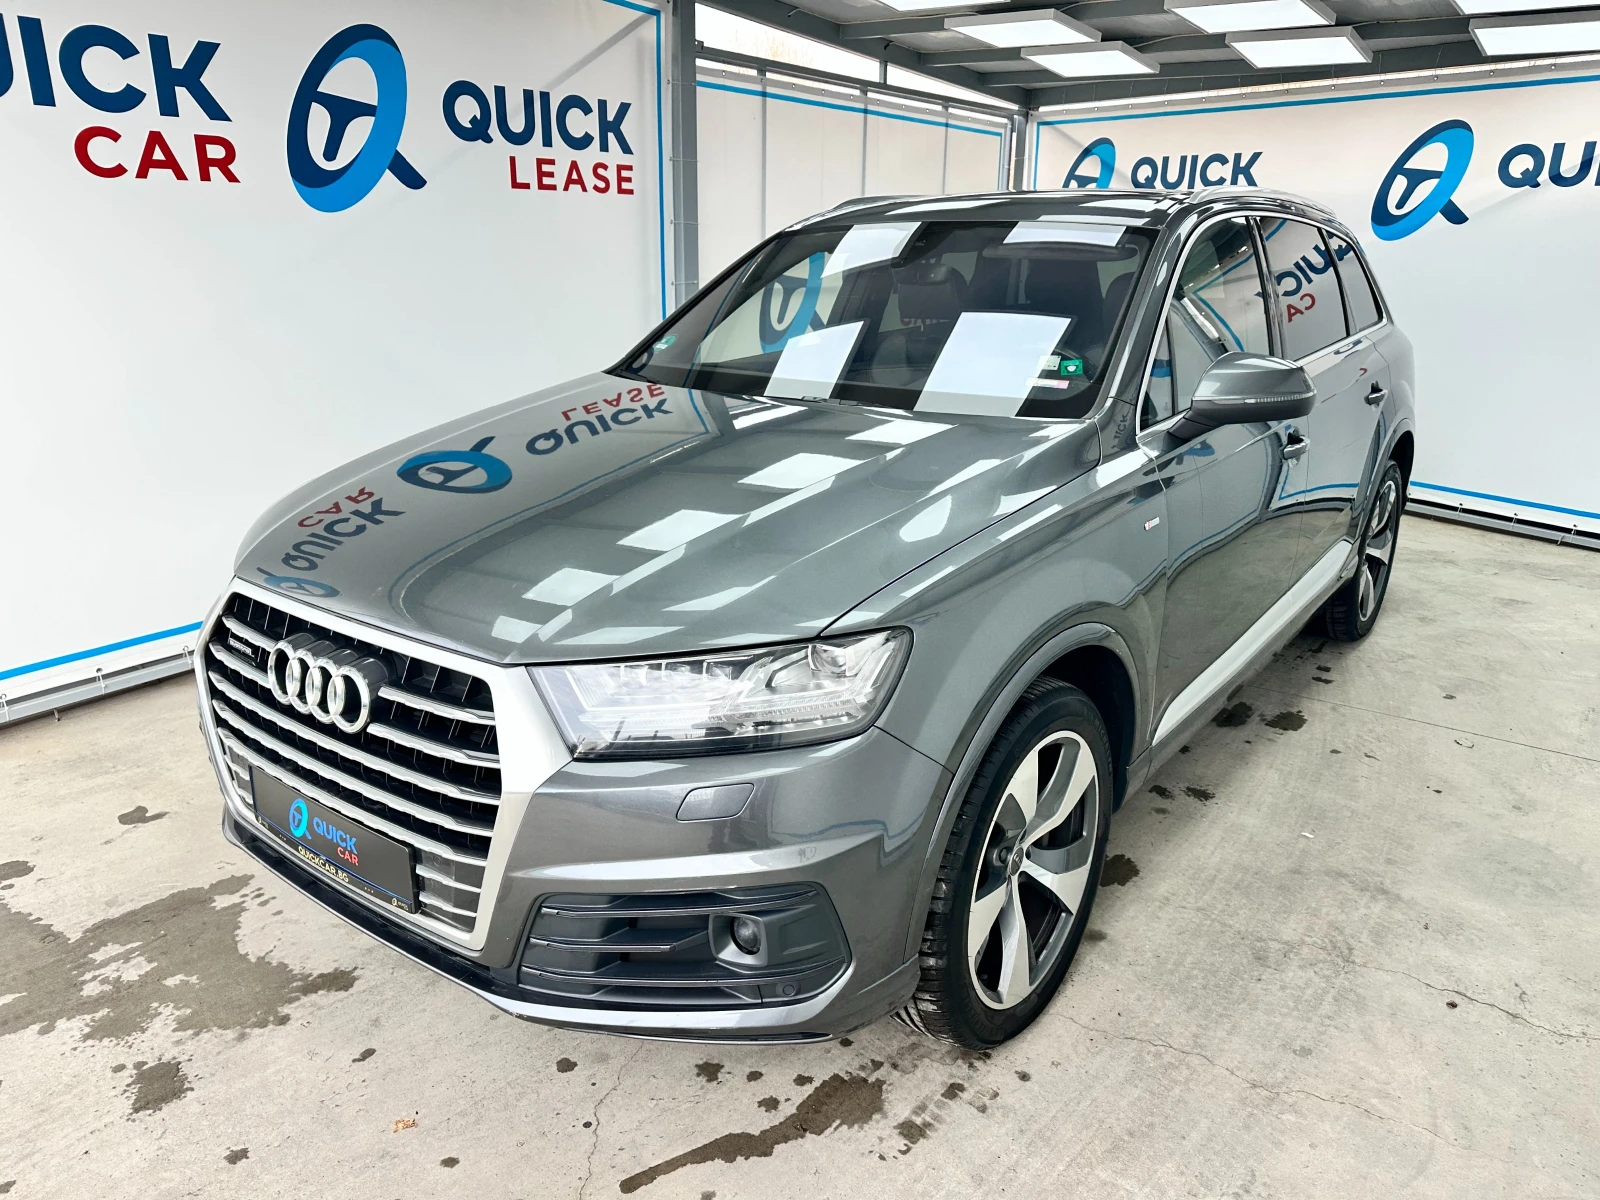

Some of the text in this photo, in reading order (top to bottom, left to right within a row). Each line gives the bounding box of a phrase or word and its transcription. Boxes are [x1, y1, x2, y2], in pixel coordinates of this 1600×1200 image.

[442, 80, 635, 155] QUICK
[74, 126, 241, 183] CAR
[1130, 151, 1263, 190] QUICK
[1497, 140, 1600, 189] QU
[509, 155, 635, 195] LEASE
[312, 816, 358, 855] QUICK
[298, 845, 349, 883] QUICKCAR.BG
[337, 846, 359, 866] CAR
